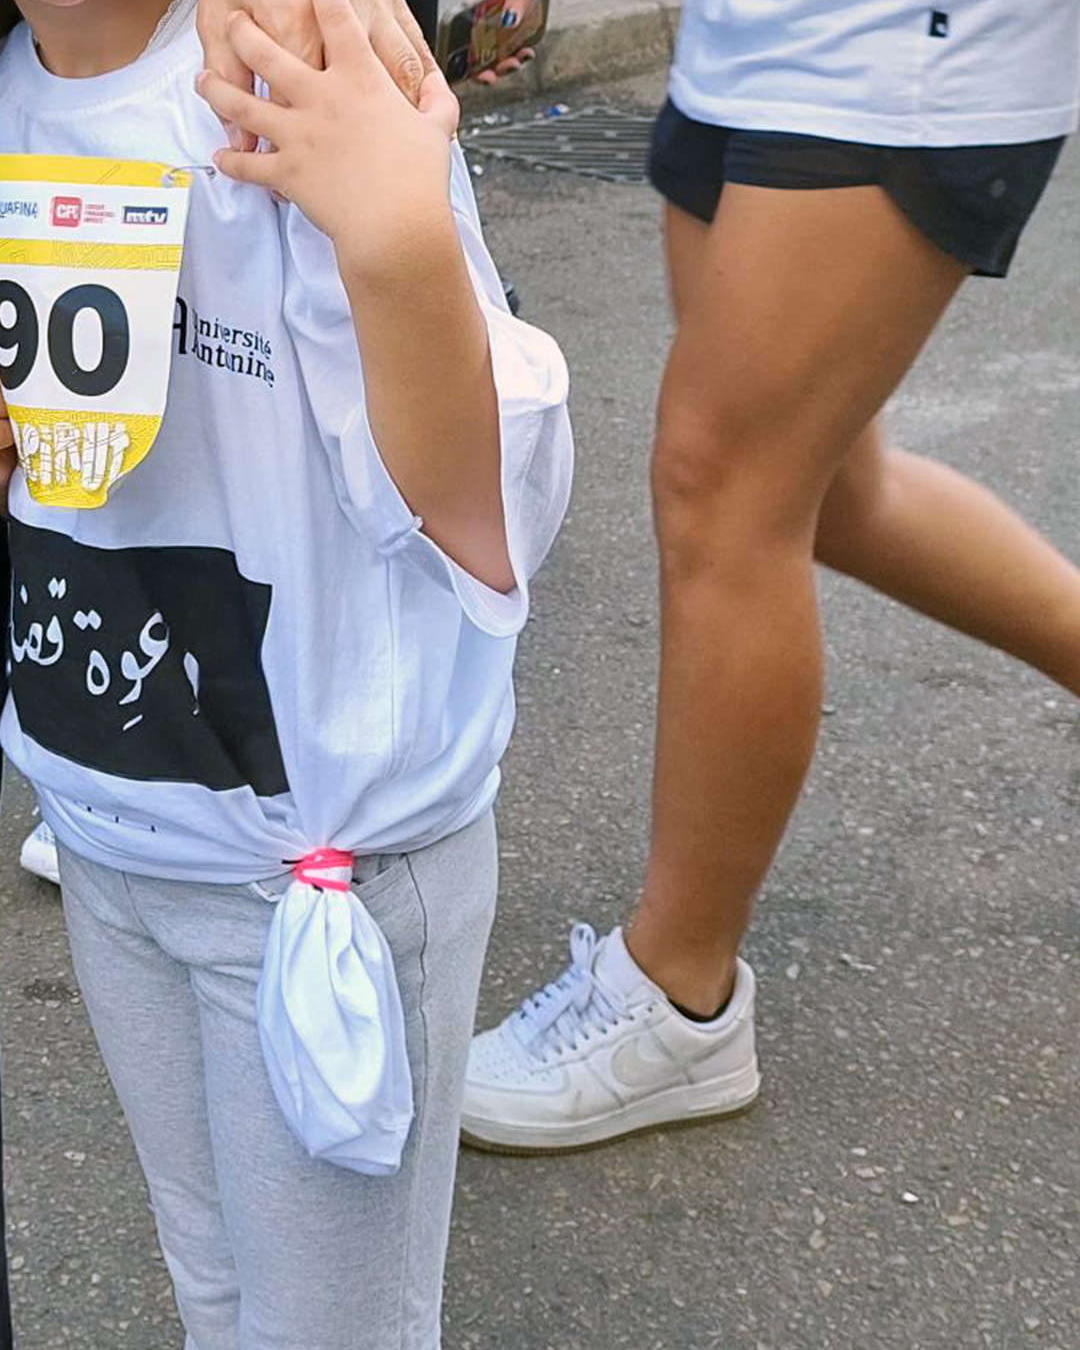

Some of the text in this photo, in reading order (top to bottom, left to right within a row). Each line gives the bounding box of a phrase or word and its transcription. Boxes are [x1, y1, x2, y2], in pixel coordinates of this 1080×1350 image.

[126, 210, 165, 224] mtv
[192, 308, 272, 360] niersié
[191, 341, 275, 388] ntnine
